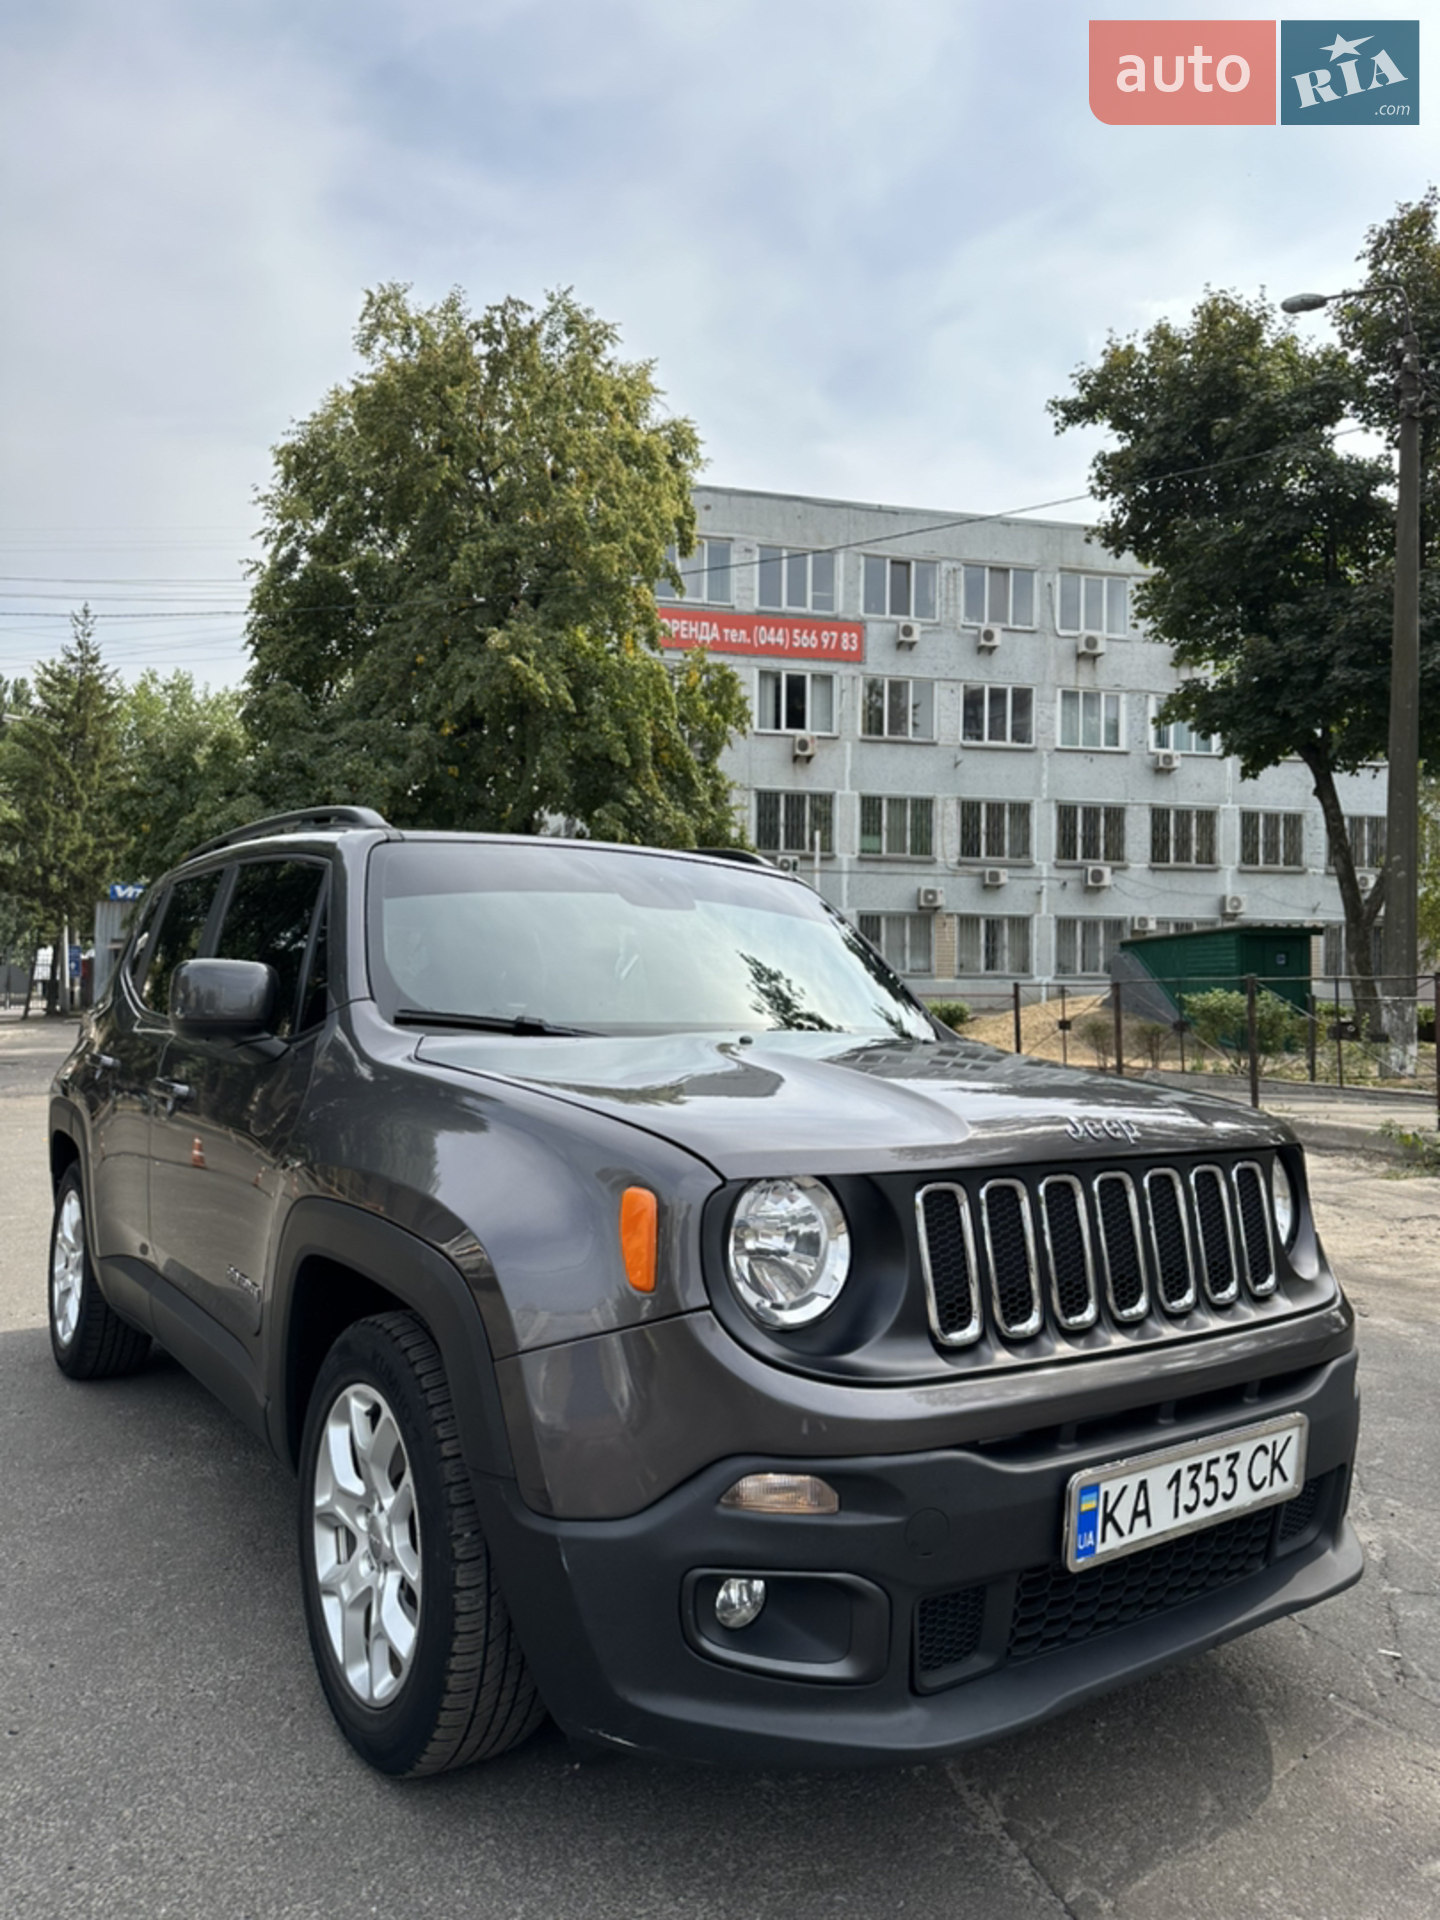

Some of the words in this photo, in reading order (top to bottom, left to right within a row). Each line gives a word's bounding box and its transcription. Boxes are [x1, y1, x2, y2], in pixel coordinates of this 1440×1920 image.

[723, 628, 750, 644] тел.
[753, 625, 789, 649] (044)
[792, 629, 818, 648] 566
[821, 632, 837, 650] 97
[841, 632, 858, 651] 83
[1064, 1115, 1142, 1146] Jeep
[1101, 1479, 1152, 1544] KA
[1167, 1451, 1241, 1519] 1353
[1248, 1435, 1292, 1492] CK
[1077, 1530, 1095, 1550] UA
